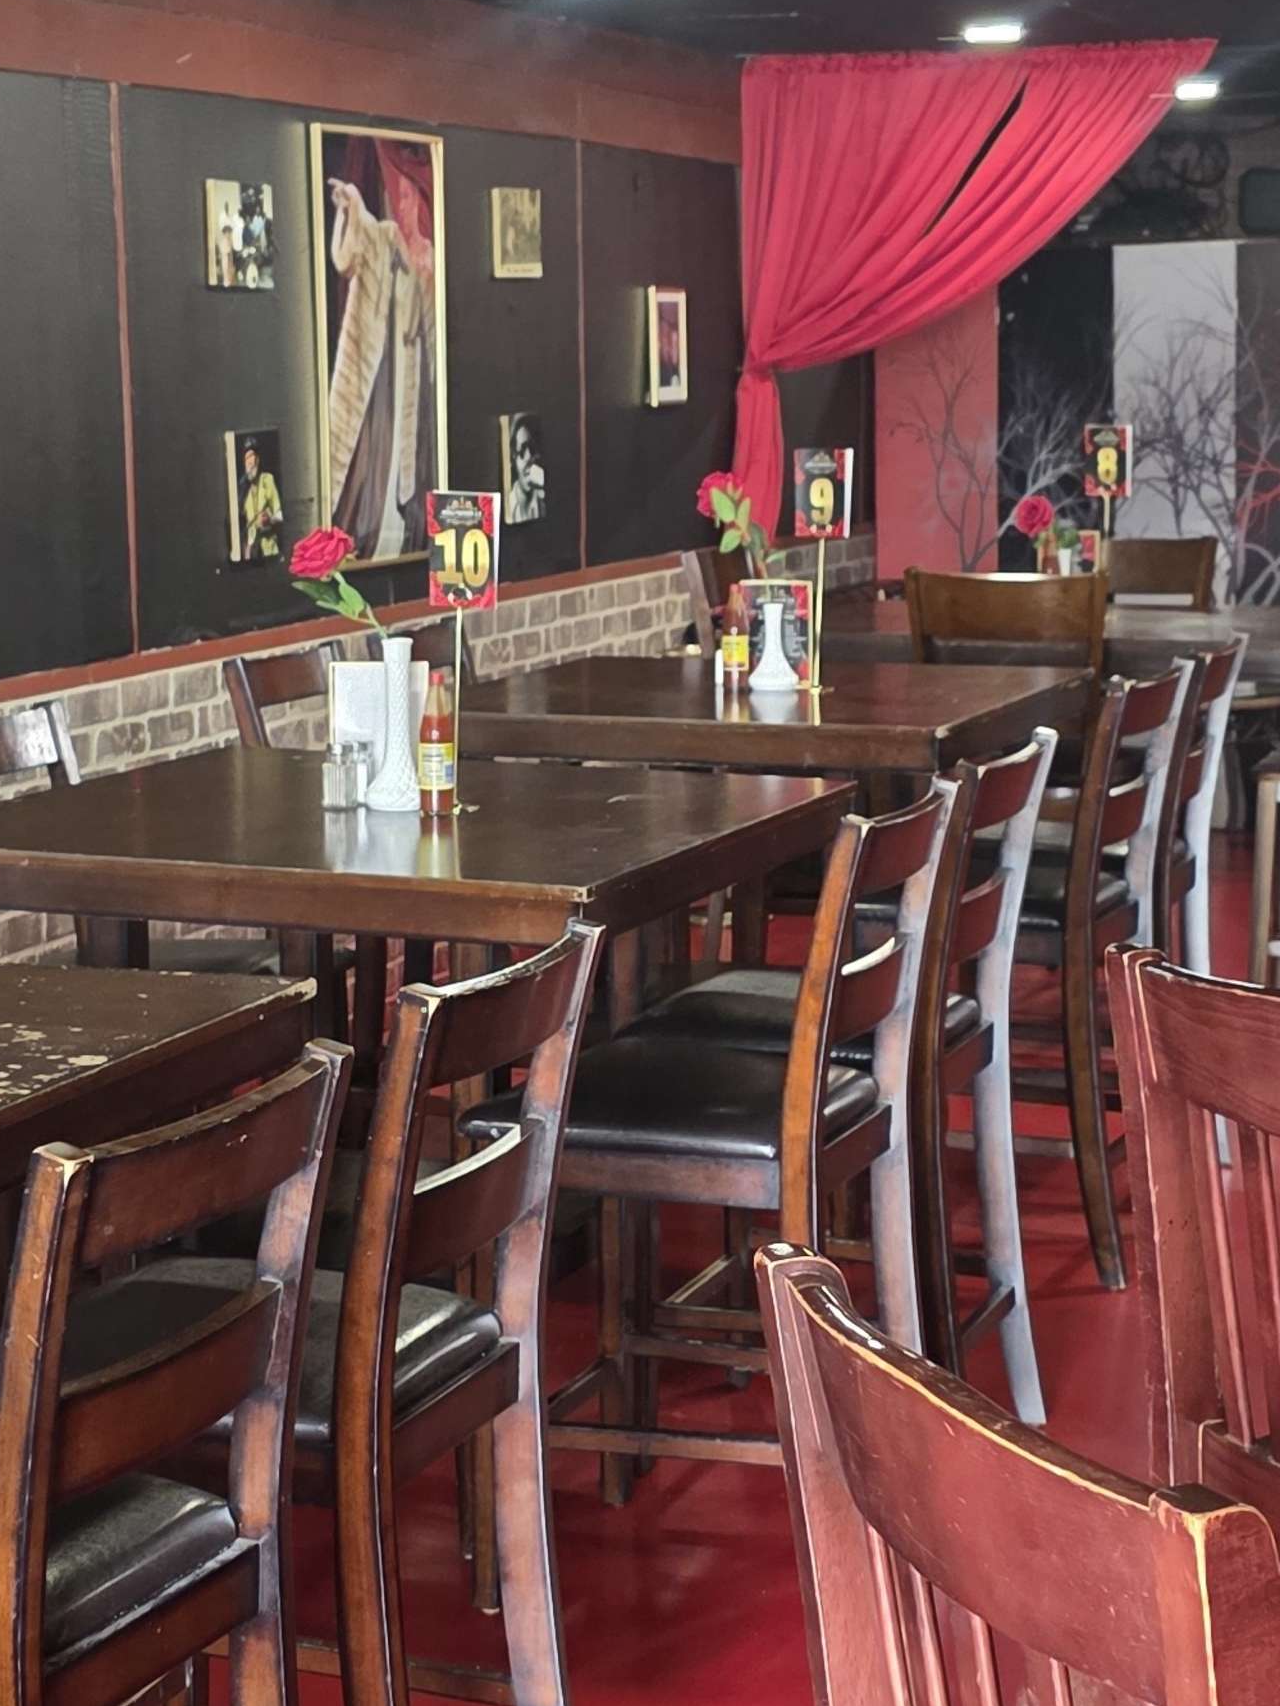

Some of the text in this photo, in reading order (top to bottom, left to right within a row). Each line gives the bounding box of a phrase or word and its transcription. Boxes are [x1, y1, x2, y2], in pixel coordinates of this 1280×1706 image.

[1097, 447, 1118, 485] 8
[810, 478, 834, 524] 9
[434, 529, 490, 587] 10
